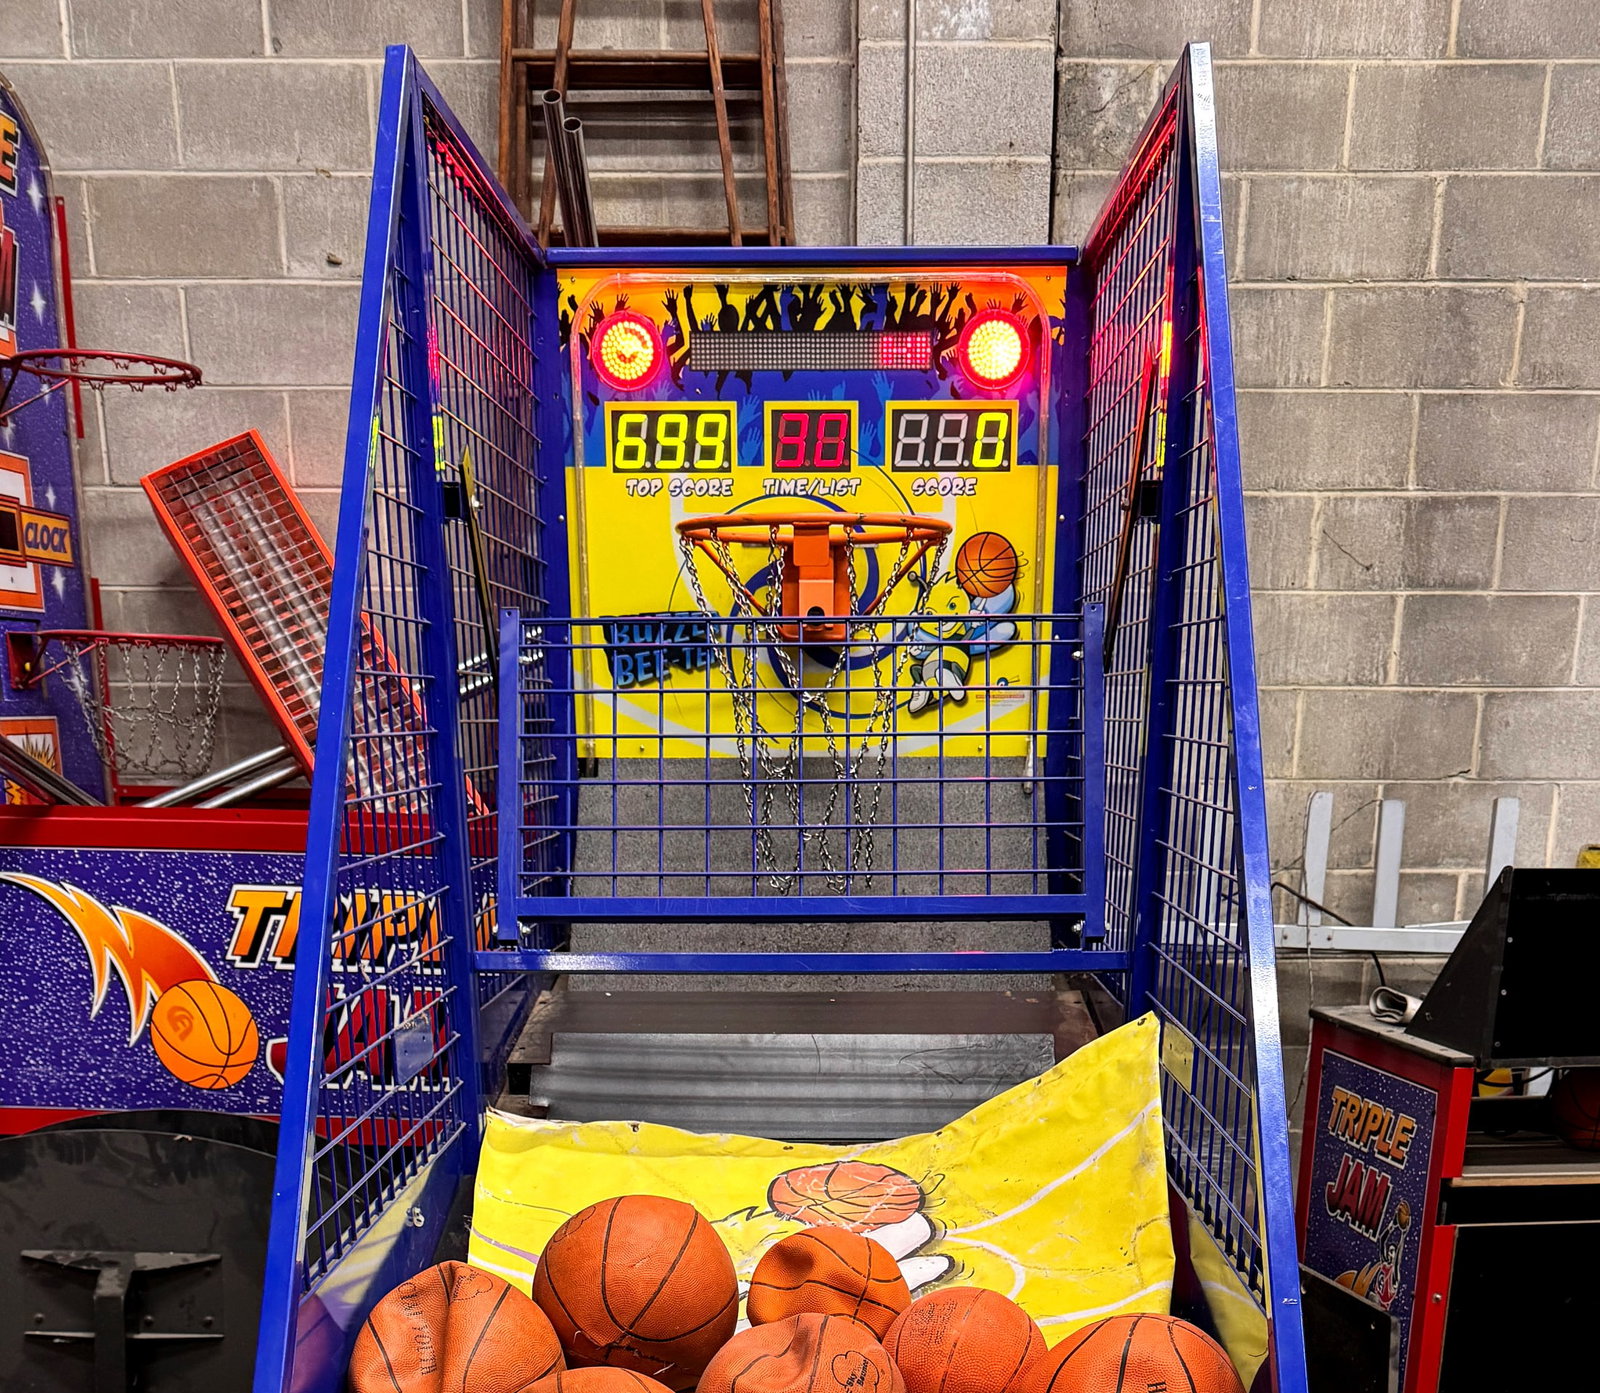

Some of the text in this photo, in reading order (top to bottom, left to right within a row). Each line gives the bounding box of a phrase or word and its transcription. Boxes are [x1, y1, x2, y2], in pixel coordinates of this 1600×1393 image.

[626, 478, 734, 497] TOP SCORE
[763, 478, 862, 496] TIME/LIST
[911, 477, 977, 497] SCORE
[25, 521, 68, 554] CLOCK
[608, 612, 722, 646] BUZZE
[1328, 1085, 1418, 1169] TRIPLE
[1325, 1152, 1393, 1243] JAM
